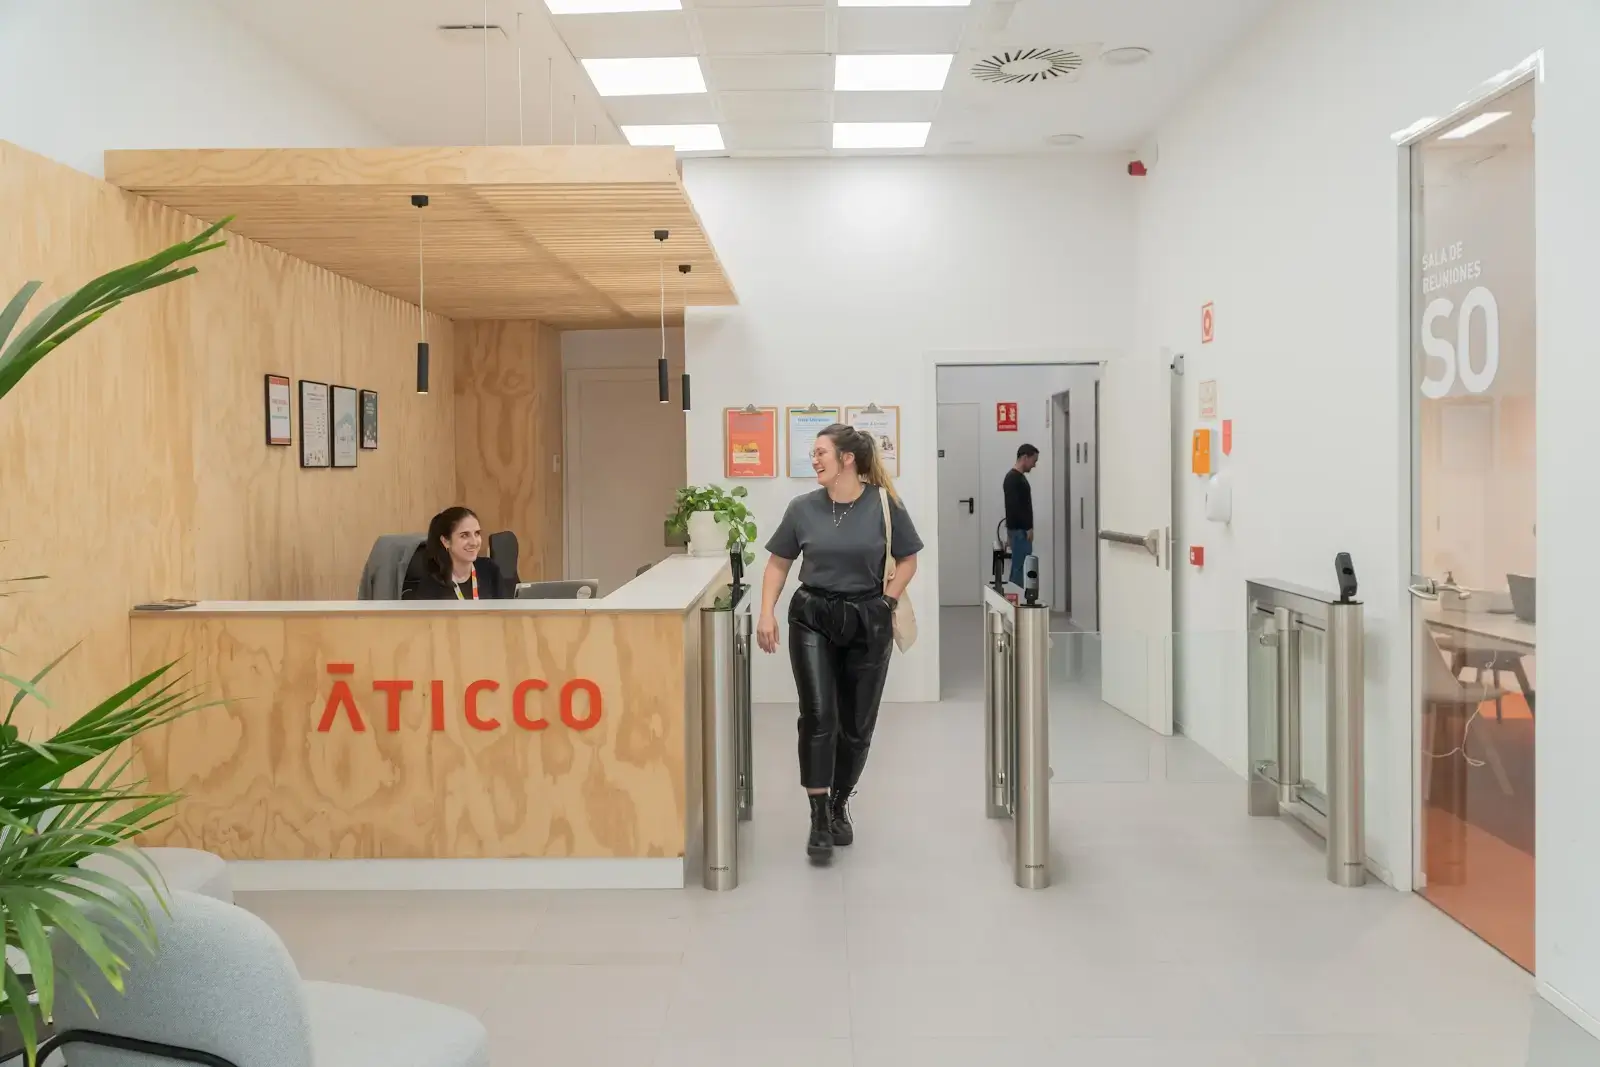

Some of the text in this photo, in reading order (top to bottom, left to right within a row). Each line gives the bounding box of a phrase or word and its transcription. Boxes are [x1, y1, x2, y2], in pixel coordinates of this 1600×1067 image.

[1422, 240, 1463, 271] SALA DE
[1422, 260, 1481, 295] REUNIONES
